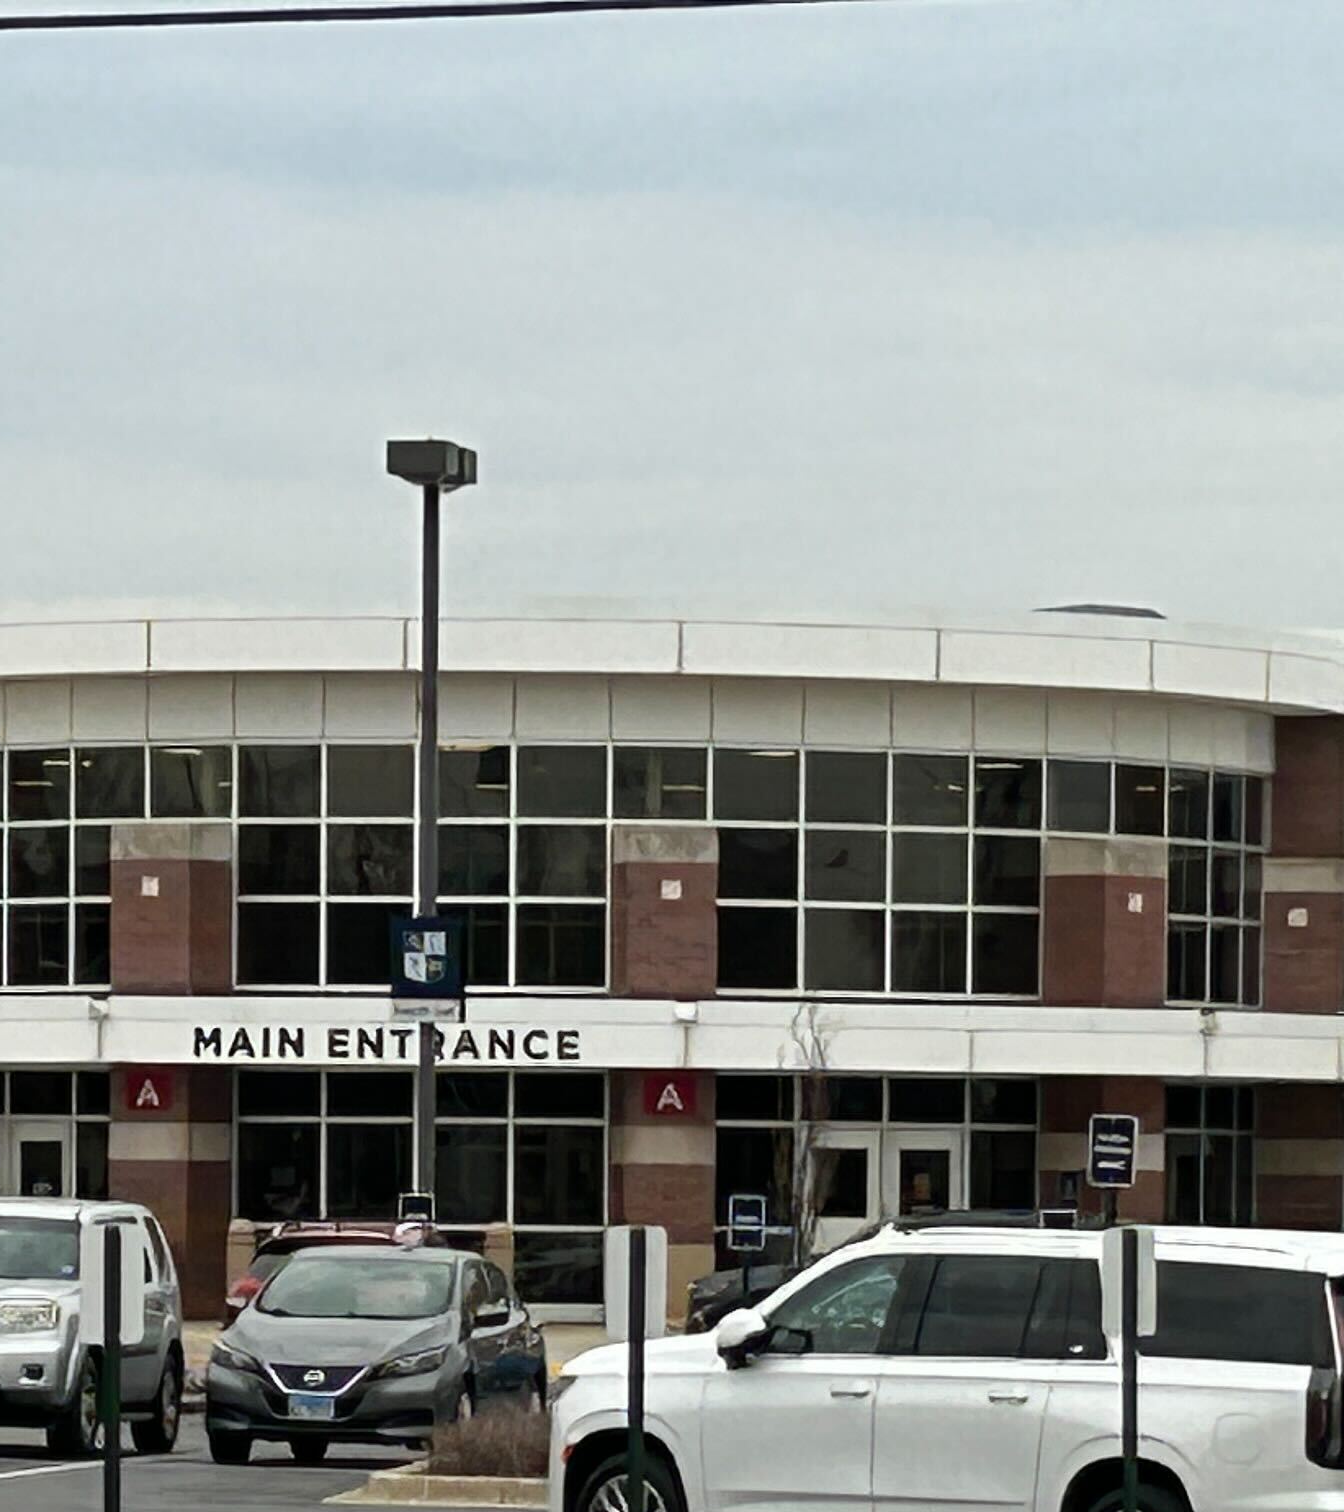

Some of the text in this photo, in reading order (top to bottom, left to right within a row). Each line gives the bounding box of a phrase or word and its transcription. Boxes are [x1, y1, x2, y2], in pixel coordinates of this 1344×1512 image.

[193, 1027, 305, 1058] MAIN
[136, 1078, 160, 1107] A
[657, 1082, 684, 1111] A
